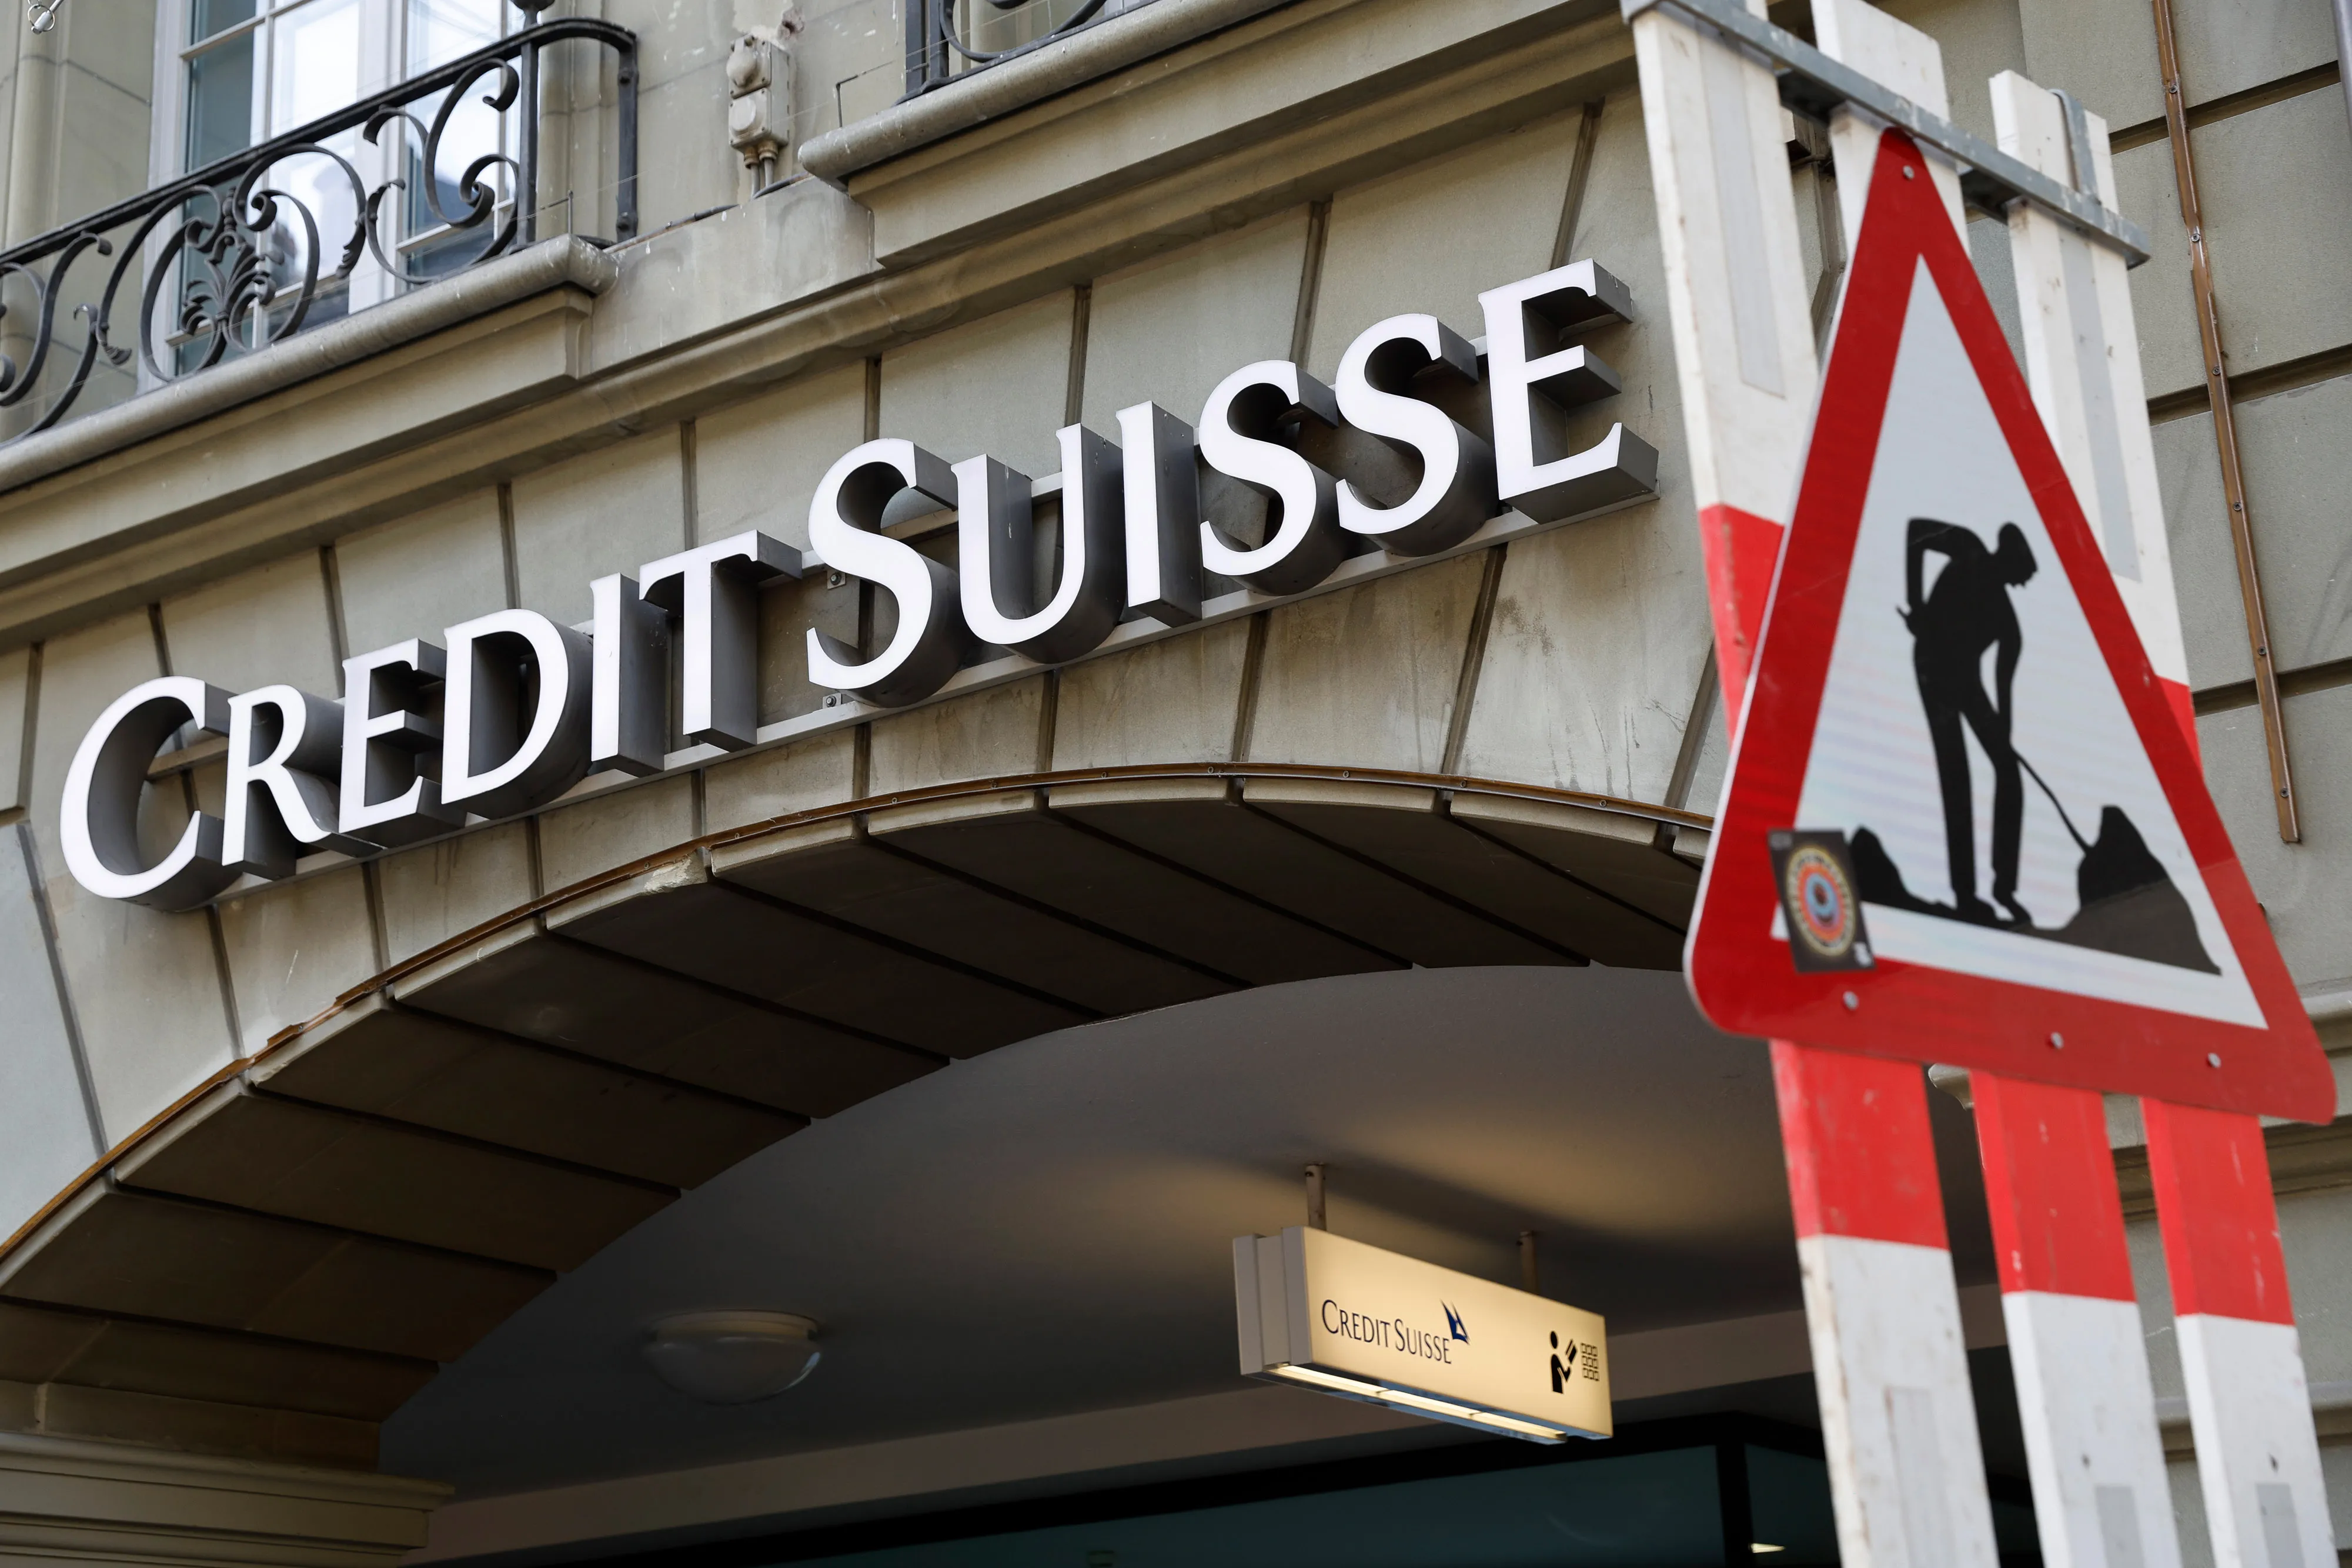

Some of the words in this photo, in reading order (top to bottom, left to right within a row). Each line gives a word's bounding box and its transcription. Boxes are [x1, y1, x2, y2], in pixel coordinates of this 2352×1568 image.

[60, 529, 759, 899] CREDIT
[806, 258, 1623, 690] SUISSE
[1322, 1299, 1391, 1348] CREDIT
[1394, 1318, 1452, 1365] SUISSE
